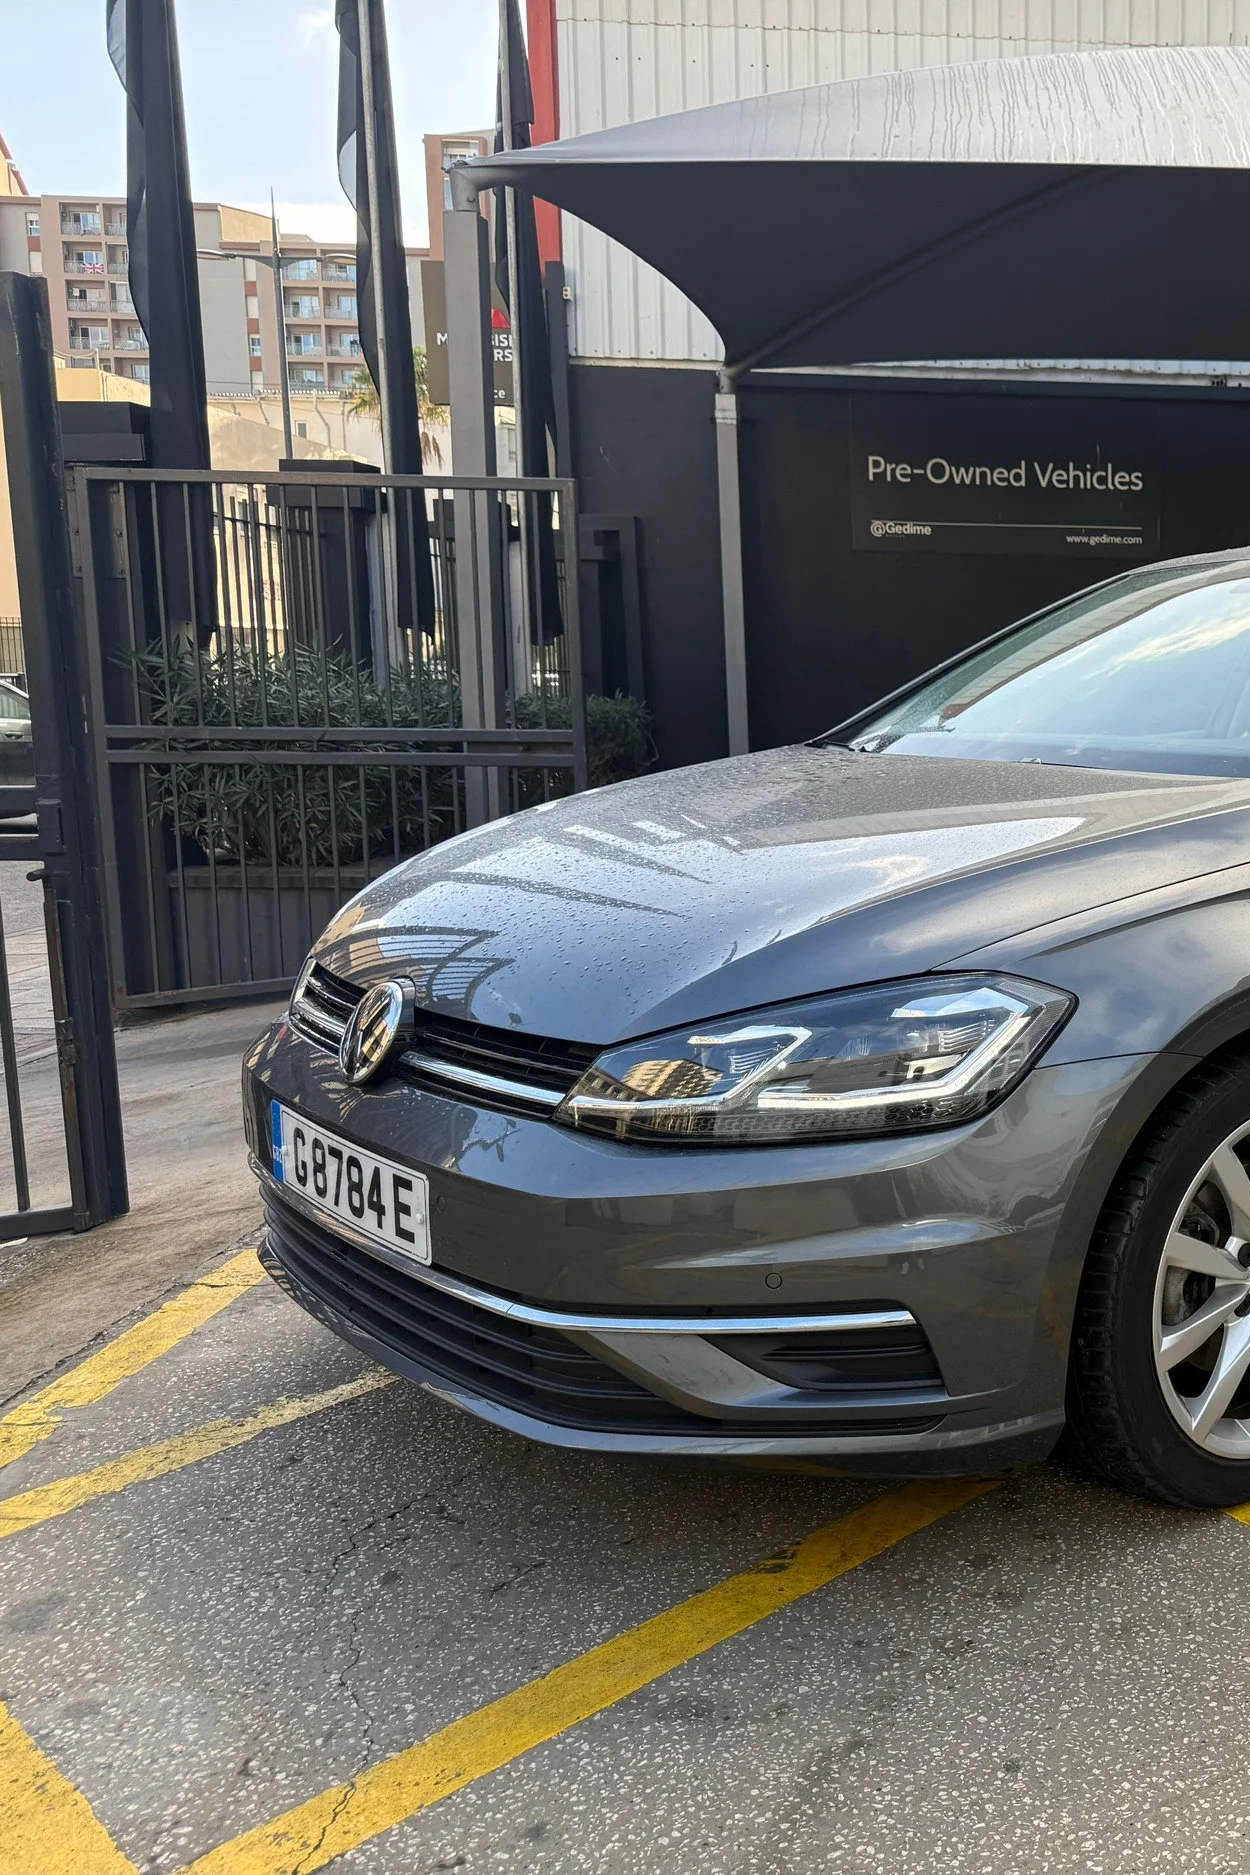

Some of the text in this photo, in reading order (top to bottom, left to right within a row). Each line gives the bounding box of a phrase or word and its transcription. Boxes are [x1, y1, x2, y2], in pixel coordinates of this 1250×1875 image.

[867, 455, 1143, 491] Pre-Owned Vehicles
[1065, 533, 1143, 546] www.gedime.com
[293, 1127, 416, 1244] G8784E
